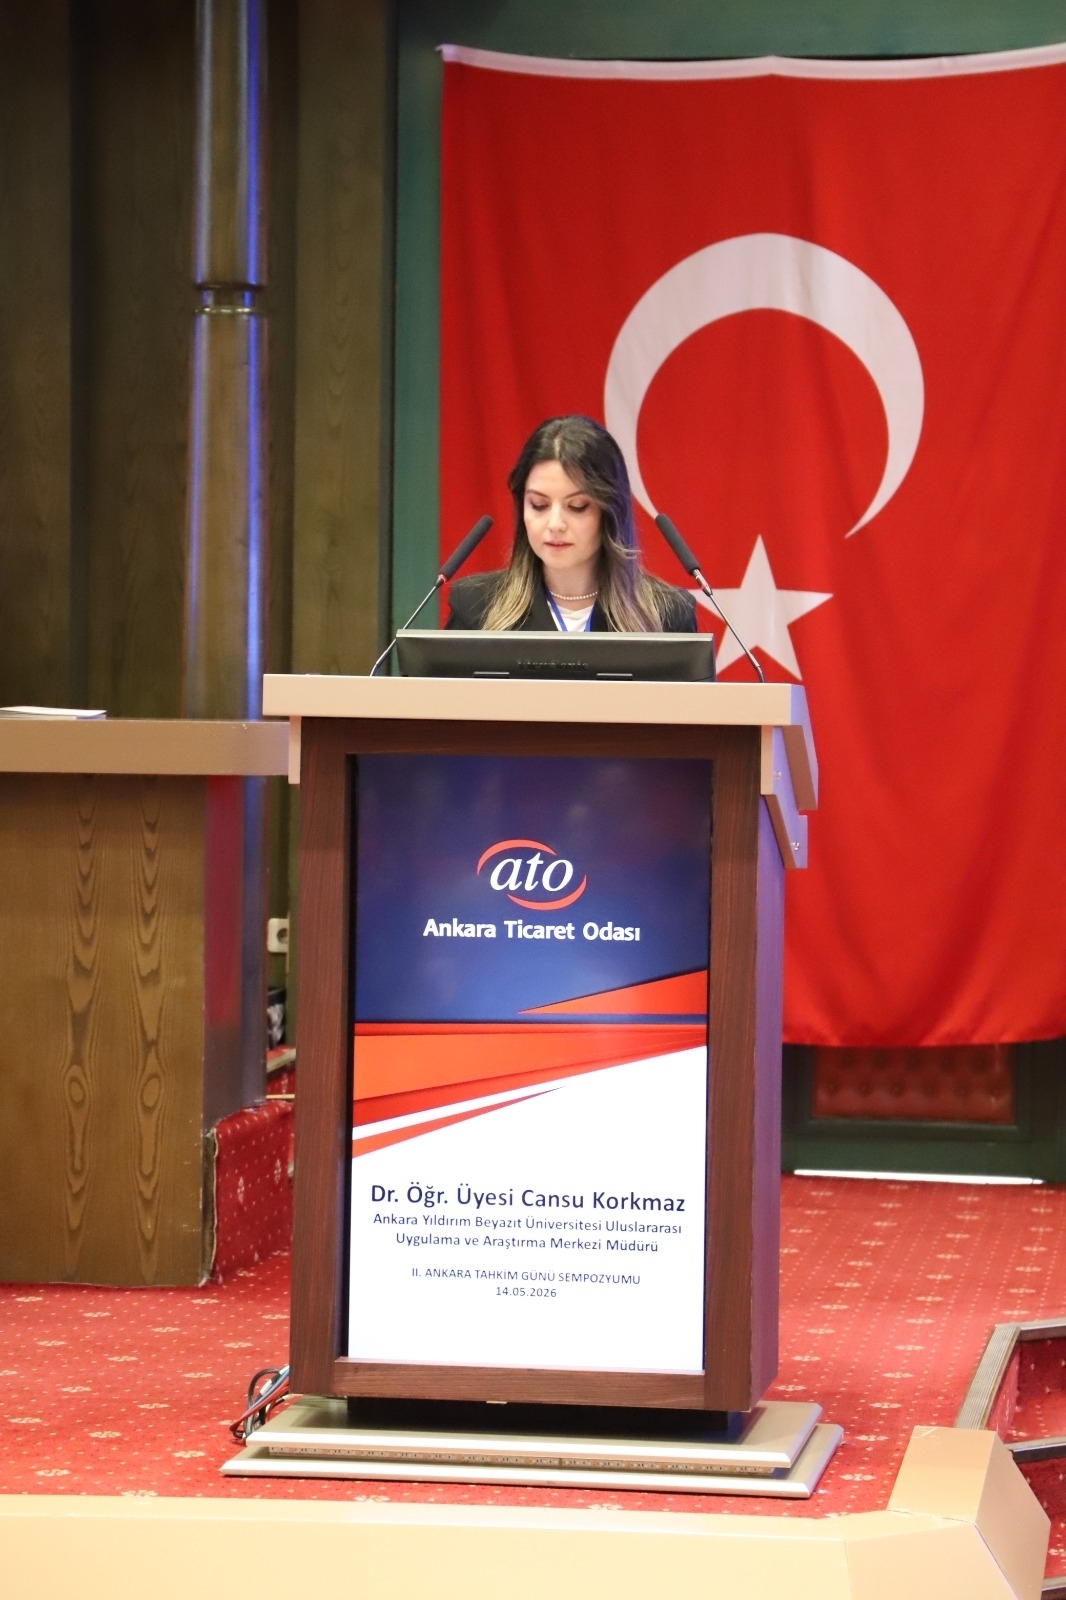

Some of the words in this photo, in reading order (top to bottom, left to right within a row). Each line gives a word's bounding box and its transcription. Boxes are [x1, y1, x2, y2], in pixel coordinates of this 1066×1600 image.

[490, 852, 574, 892] ato
[422, 917, 497, 939] Ankara
[503, 919, 576, 941] Ticaret
[582, 921, 641, 942] Odası
[371, 1184, 399, 1203] Dr.
[406, 1181, 448, 1208] Öğr.
[457, 1183, 513, 1210] Üyesi
[521, 1189, 584, 1209] Cansu
[592, 1191, 686, 1212] Korkmaz
[373, 1213, 418, 1225] Ankara
[422, 1214, 471, 1227] Yıldırım
[475, 1216, 522, 1230] Beyazıt
[525, 1216, 602, 1231] Üniversitesi
[605, 1220, 682, 1234] Uluslararası
[396, 1233, 460, 1247] Uygulama
[464, 1237, 479, 1246] ve
[482, 1235, 546, 1249] Araştırma
[550, 1238, 602, 1250] Merkezi
[606, 1239, 658, 1252] Müdürü
[411, 1267, 422, 1278] II.
[425, 1268, 472, 1279] ANKARA
[475, 1268, 518, 1280] TAHKİM
[521, 1270, 555, 1282] GÜNÜ
[558, 1272, 641, 1285] SEMPOZYUMU
[495, 1286, 557, 1298] 14.05.2026
